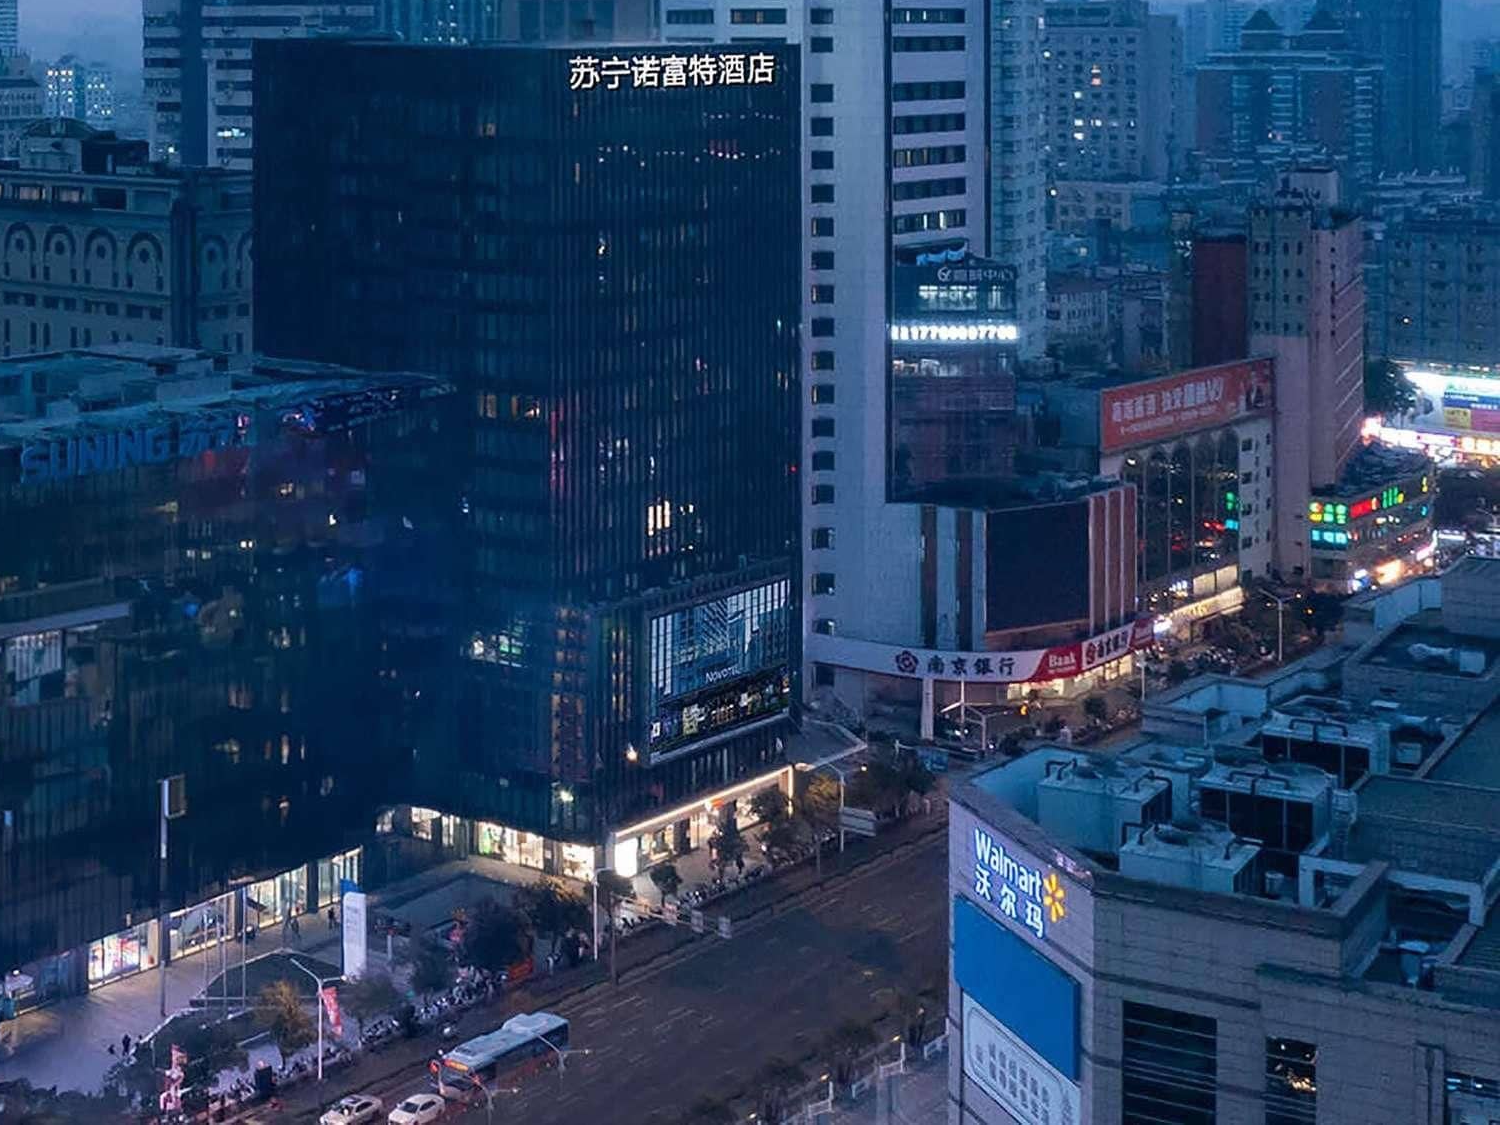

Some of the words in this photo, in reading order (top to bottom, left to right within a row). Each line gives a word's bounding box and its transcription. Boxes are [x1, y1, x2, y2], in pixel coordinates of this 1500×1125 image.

[568, 51, 775, 90] 苏宁诺富特酒店
[20, 424, 172, 484] SUNING
[927, 655, 1017, 676] 南京银行
[974, 827, 1043, 903] Walmart
[975, 864, 1045, 938] 沃尔玛
